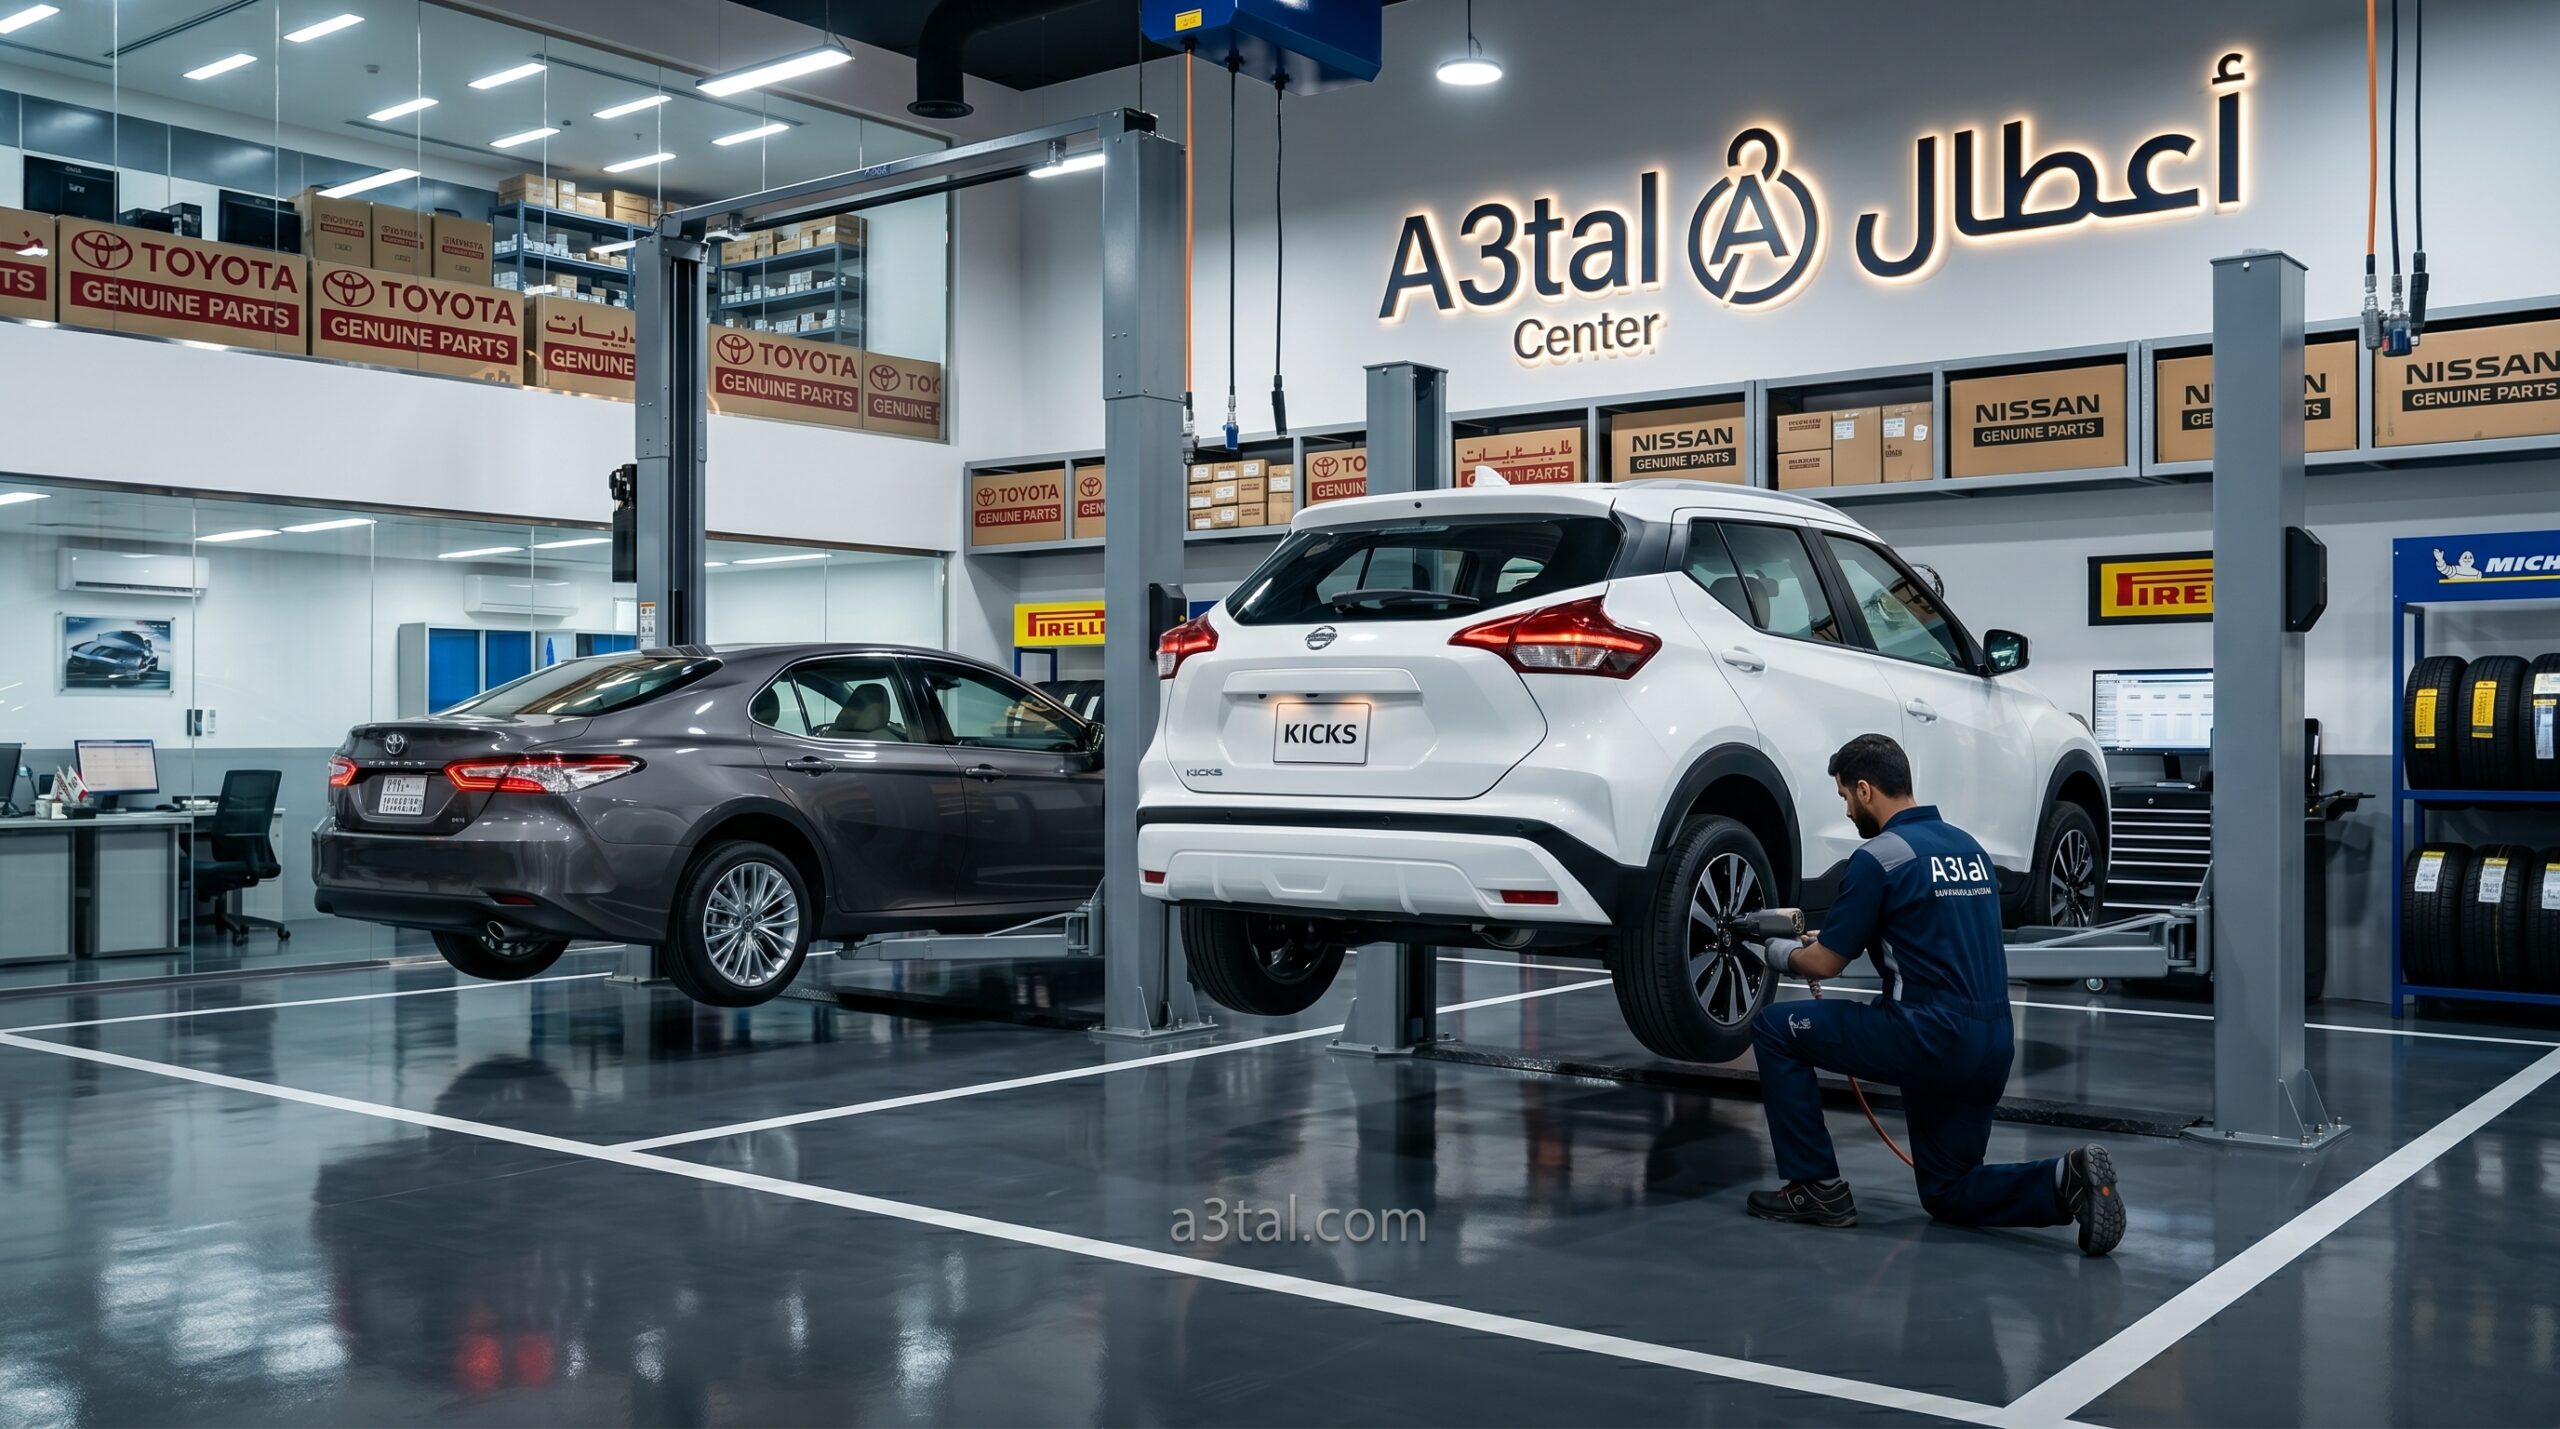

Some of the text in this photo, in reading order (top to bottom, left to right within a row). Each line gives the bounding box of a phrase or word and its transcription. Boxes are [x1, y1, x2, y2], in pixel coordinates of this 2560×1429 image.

[1855, 53, 2246, 278] أعطال
[1378, 171, 1660, 319] A3tal
[141, 242, 298, 294] TOYOTA
[82, 280, 290, 328] GENUINE PARTS
[381, 281, 516, 326] TOYOTA
[331, 317, 509, 359] GENUINE PARTS
[1513, 312, 1661, 359] Center
[551, 349, 634, 376] GENUINE
[759, 342, 857, 379] TOYOTA
[2406, 350, 2560, 385] NISSAN
[722, 374, 853, 408] GENUINE PARTS
[2412, 383, 2558, 406] GENUINE PARTS
[873, 399, 932, 420] GENUINE
[1976, 394, 2099, 423] NISSAN
[1632, 427, 1733, 452] NISSAN
[1981, 422, 2096, 442] GENUINE PARTS
[1526, 466, 1569, 480] PARTS
[1636, 452, 1729, 470] GENUINE PARTS
[999, 484, 1059, 503] TOYOTA
[1316, 483, 1366, 497] GENUIN
[1024, 508, 1057, 520] PARTS
[1082, 503, 1105, 515] GEN
[2484, 555, 2560, 573] MICH
[2116, 568, 2213, 606] PIRE
[1284, 724, 1357, 745] KICKS
[1186, 768, 1223, 777] KICKS
